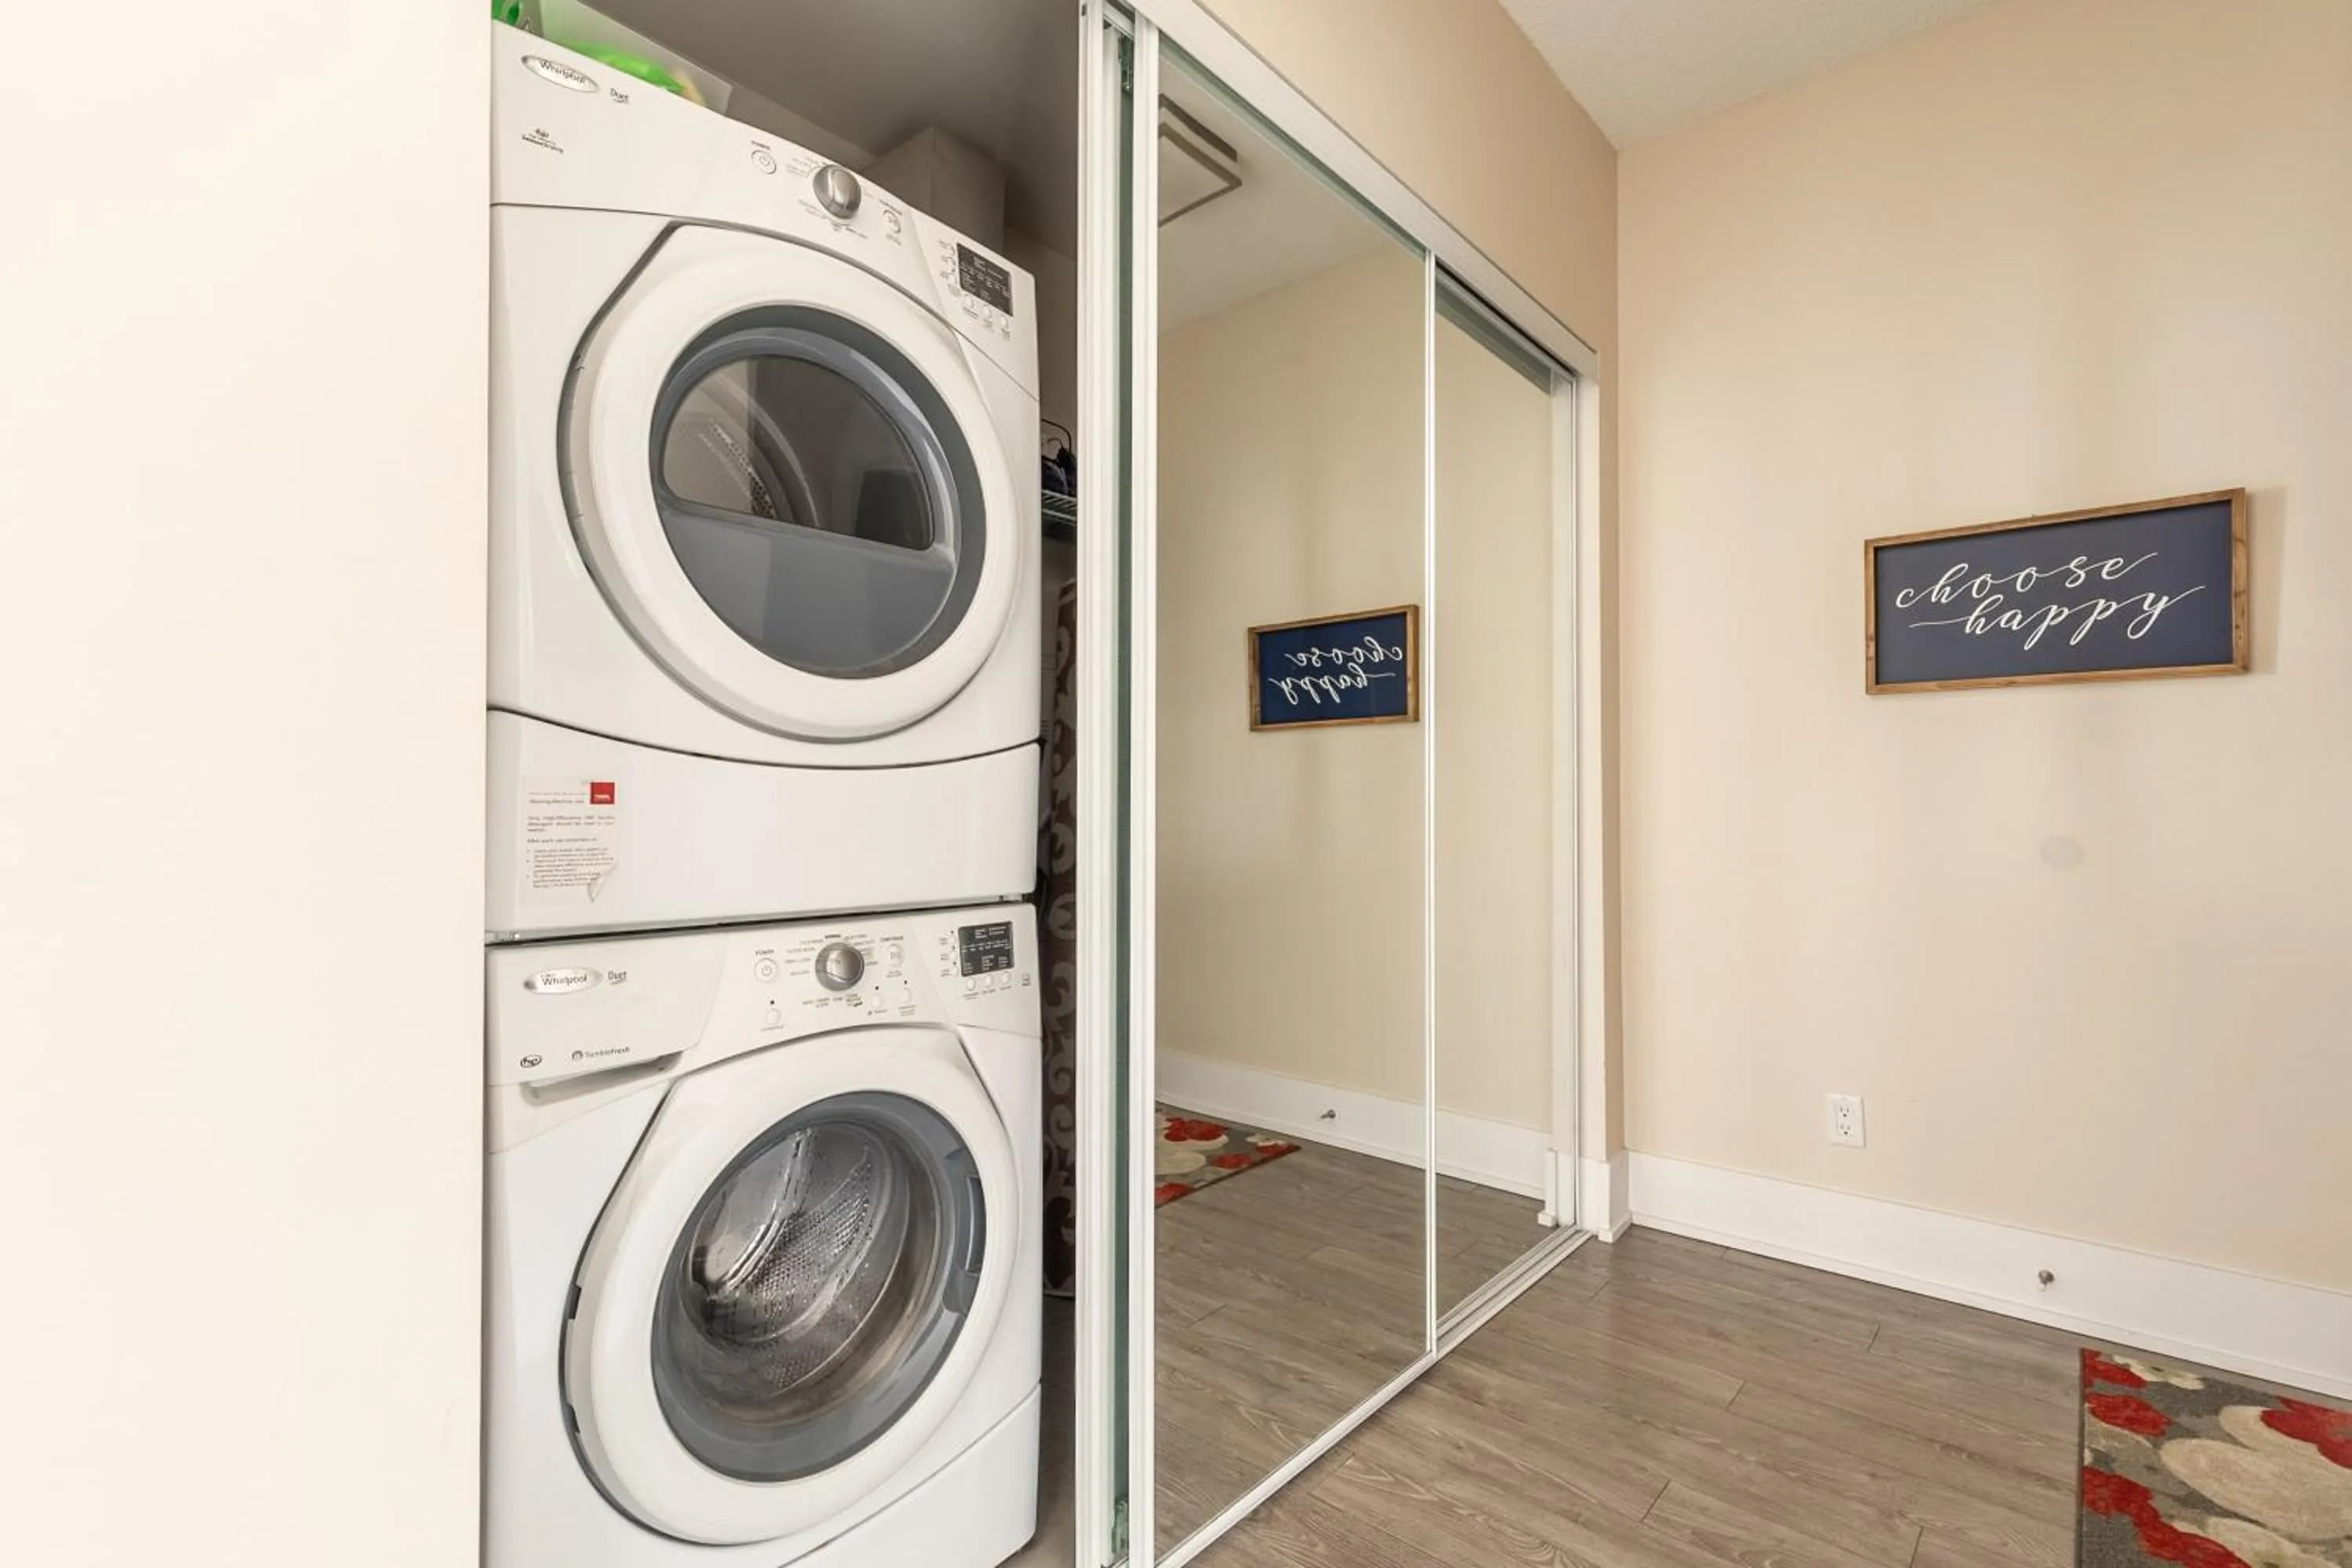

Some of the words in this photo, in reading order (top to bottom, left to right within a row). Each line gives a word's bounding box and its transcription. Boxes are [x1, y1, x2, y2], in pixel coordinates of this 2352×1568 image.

[1894, 551, 2158, 608] choose
[1908, 585, 2206, 652] happy
[541, 973, 587, 987] Whirlpool
